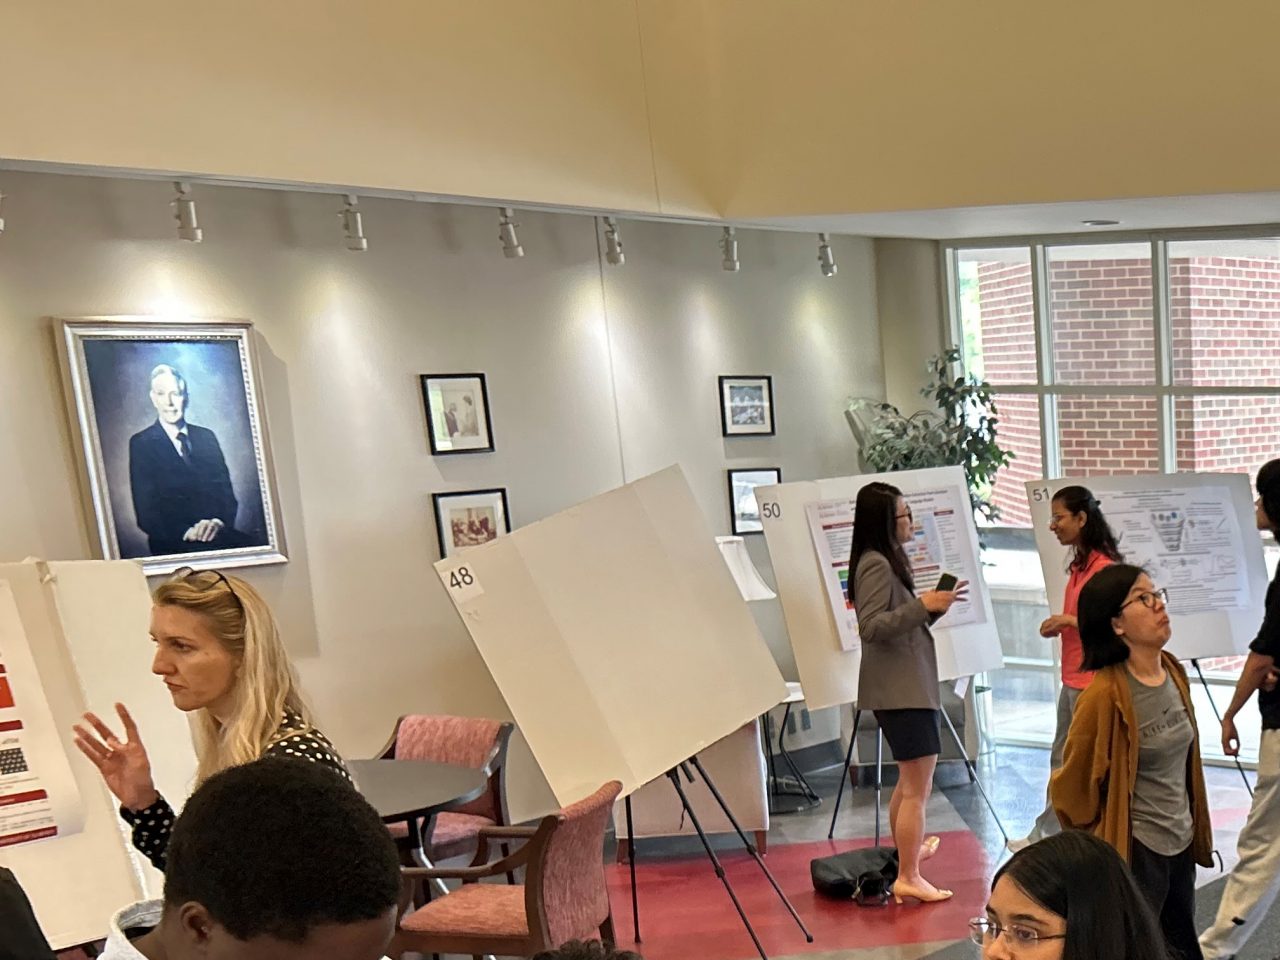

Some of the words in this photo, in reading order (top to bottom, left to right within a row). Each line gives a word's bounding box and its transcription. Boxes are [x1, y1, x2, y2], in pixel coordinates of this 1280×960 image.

[1033, 487, 1049, 501] 51
[762, 502, 781, 518] 50
[450, 566, 473, 588] 48
